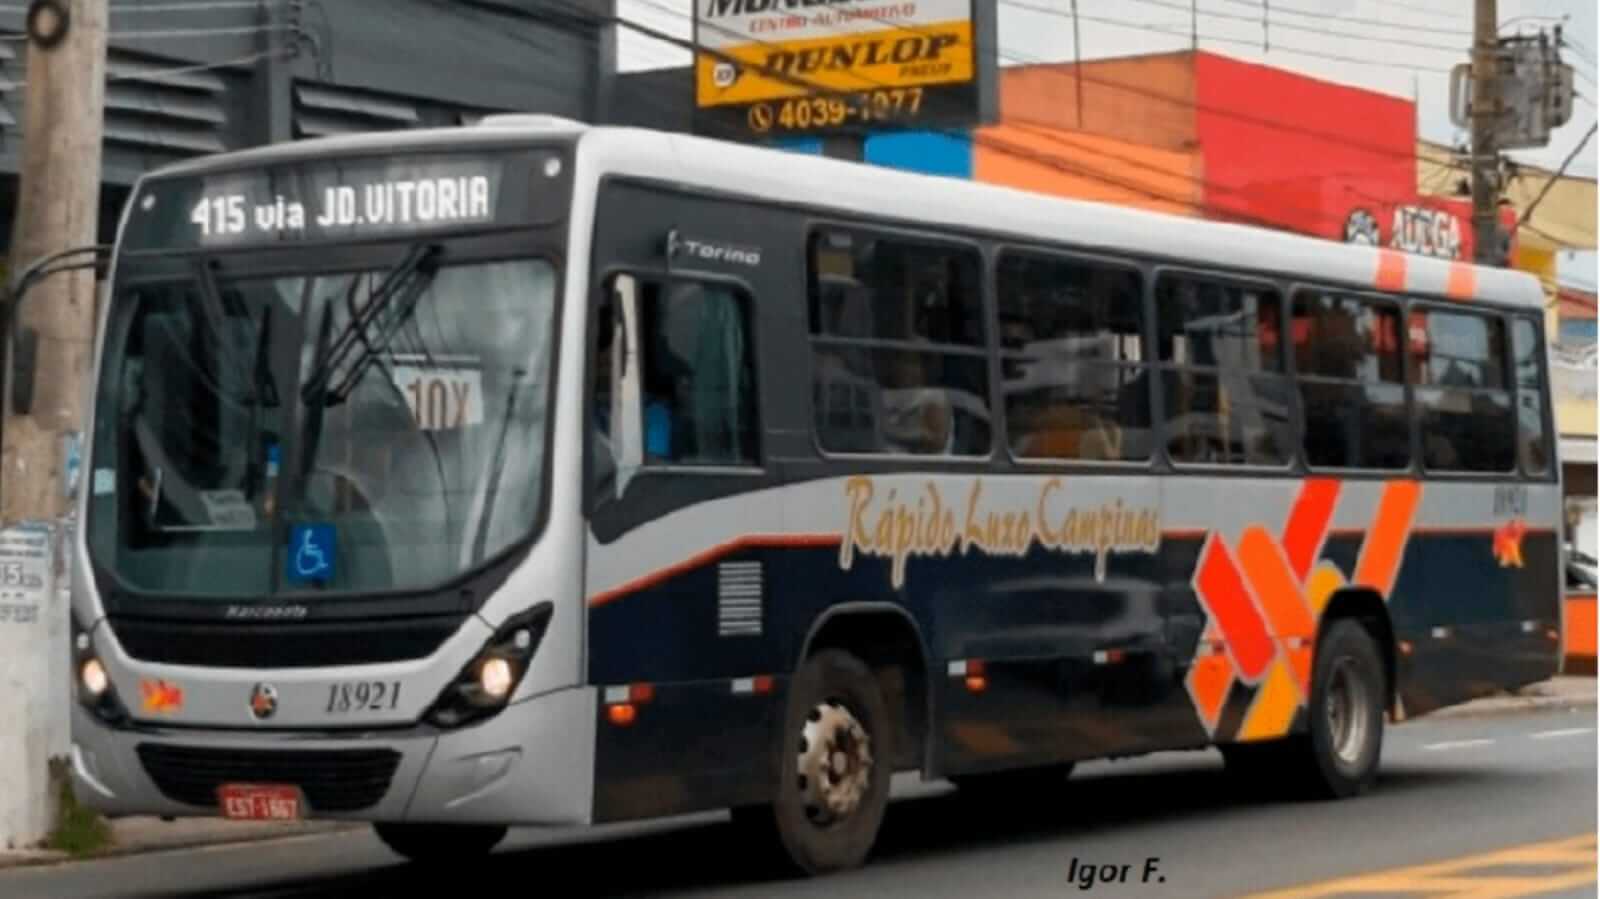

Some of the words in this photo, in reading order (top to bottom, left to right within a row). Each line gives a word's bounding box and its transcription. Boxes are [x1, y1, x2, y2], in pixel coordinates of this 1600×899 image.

[765, 34, 960, 76] DUNLOP
[191, 195, 247, 236] 415
[255, 194, 305, 231] via
[316, 175, 489, 227] JD.VITORIA
[683, 240, 761, 266] Torino
[839, 474, 956, 590] Rápido
[961, 476, 1033, 556] Luxo
[1036, 475, 1162, 584] Campinas
[325, 680, 402, 714] 18921
